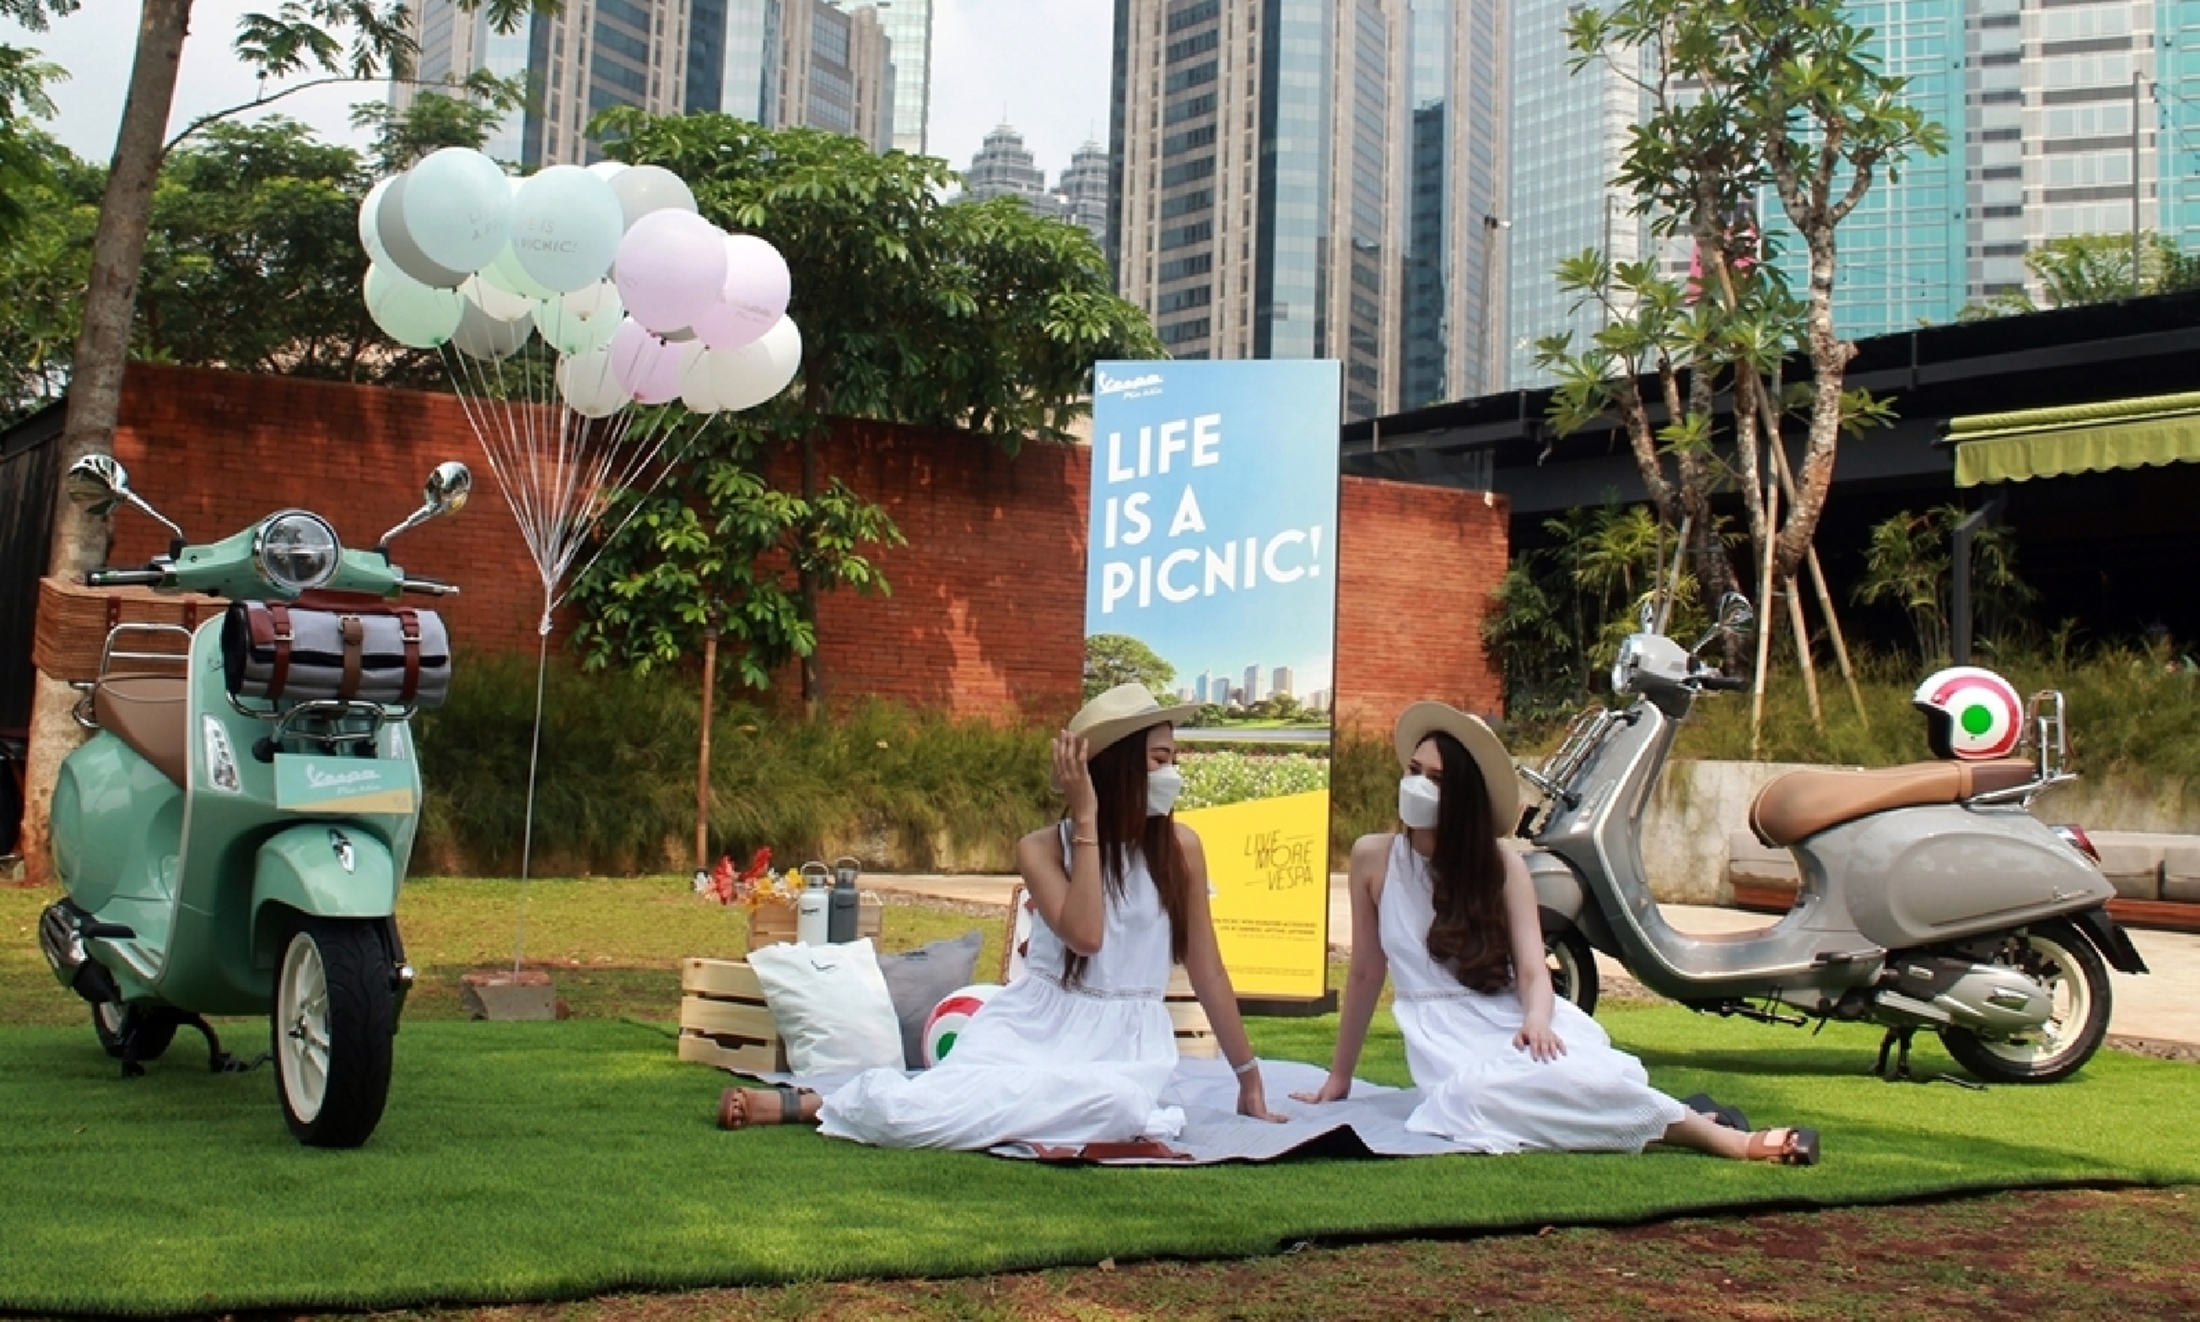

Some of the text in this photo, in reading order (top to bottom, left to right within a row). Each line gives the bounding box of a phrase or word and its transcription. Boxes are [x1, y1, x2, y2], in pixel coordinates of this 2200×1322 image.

[1108, 413, 1222, 484] LIFE
[1104, 483, 1207, 549] IS A
[1102, 525, 1323, 613] PICNIC!
[1244, 829, 1281, 856] LIVE
[1255, 839, 1314, 870] MORE
[1268, 866, 1314, 891] VESPA
